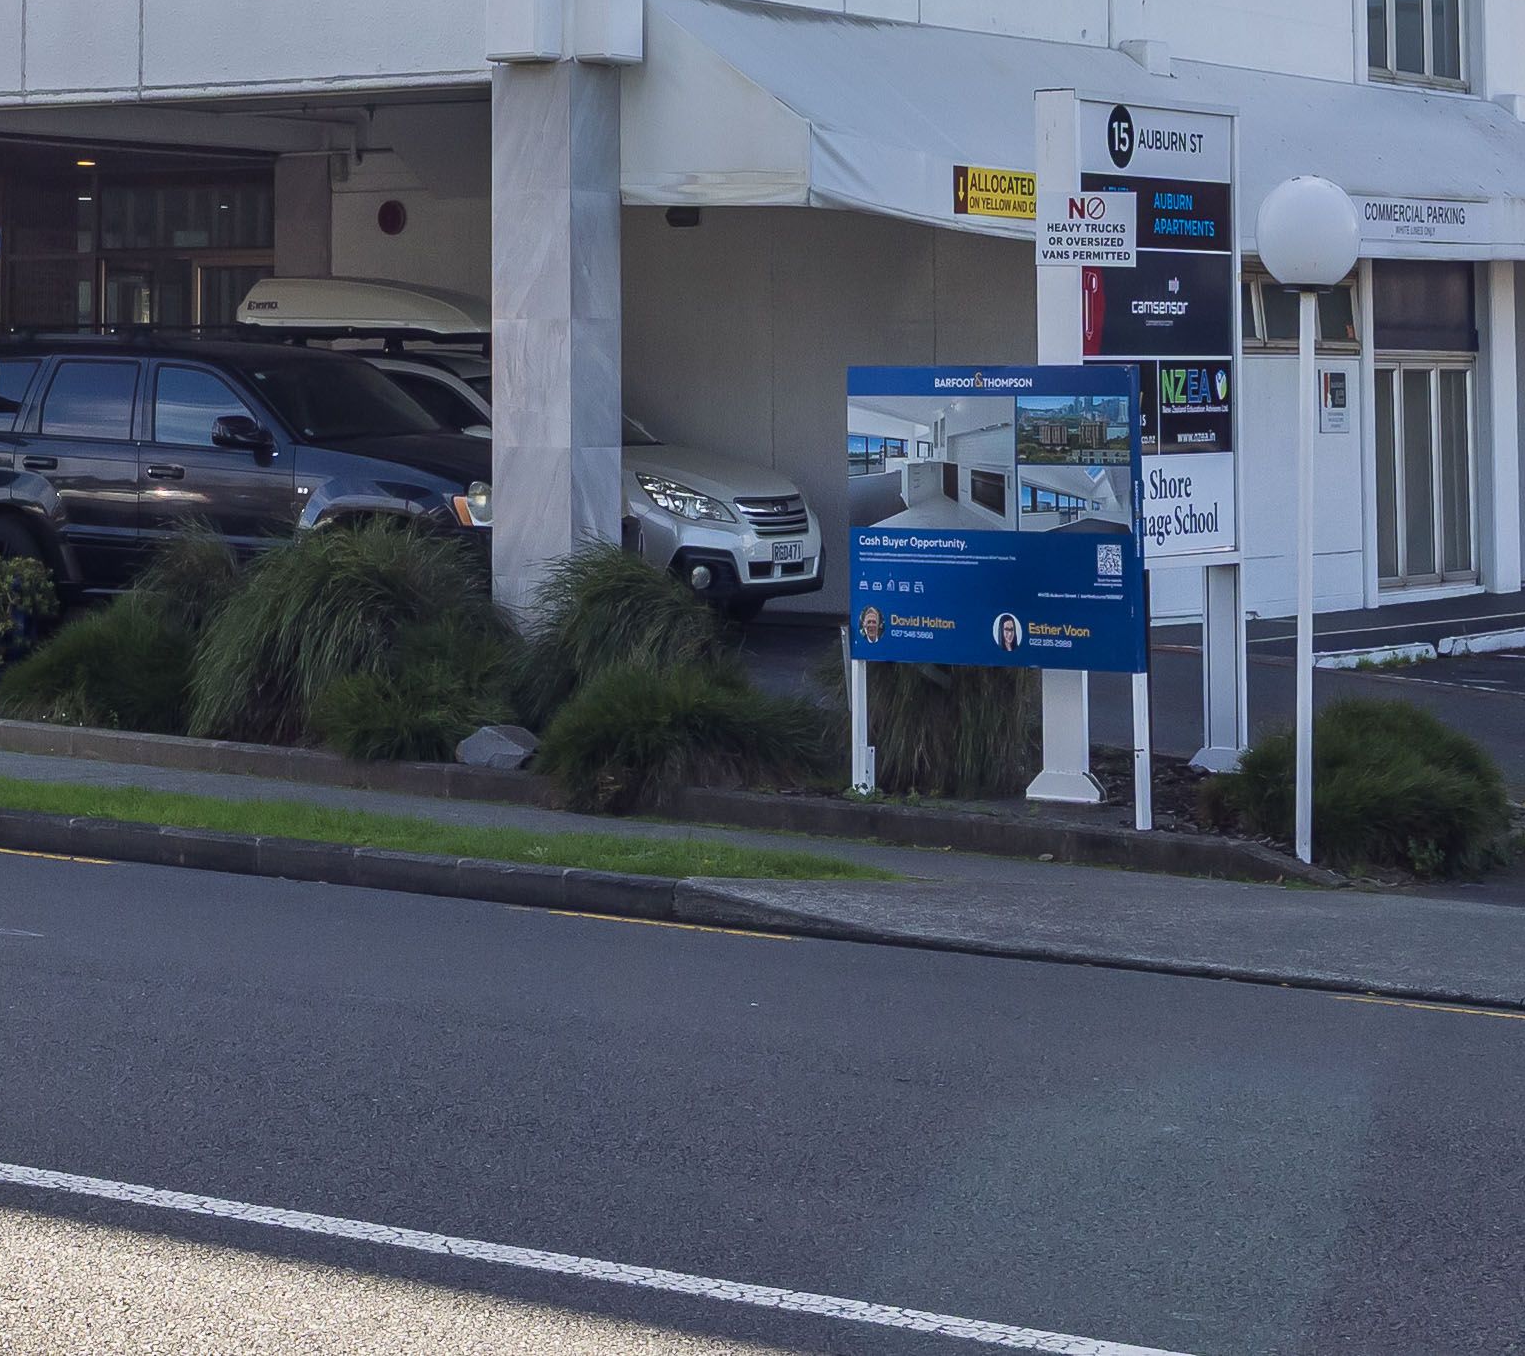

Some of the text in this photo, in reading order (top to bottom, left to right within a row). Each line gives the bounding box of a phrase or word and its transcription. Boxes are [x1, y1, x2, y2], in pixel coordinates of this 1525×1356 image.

[1112, 120, 1203, 154] 15 AUBURN ST
[970, 173, 1035, 195] ALLOCATED
[969, 198, 980, 210] ON
[981, 198, 1012, 212] YELLOW
[1013, 200, 1028, 214] AND
[1153, 192, 1192, 210] AUBURN
[1364, 202, 1465, 225] COMMERCIAL PARKING
[1047, 223, 1126, 234] HEAVY TRUCKS
[1153, 217, 1215, 237] APARTMENTS
[1048, 236, 1124, 247] OR OVERSIZED
[1042, 250, 1131, 261] VANS PERMITTED
[1131, 300, 1189, 316] camsensor
[1162, 369, 1211, 403] NZEA
[1150, 468, 1192, 500] Shore
[1175, 502, 1219, 536] School
[859, 535, 968, 551] Cash Buyer Opportunity.
[890, 614, 920, 627] David
[1028, 622, 1090, 637] Esther Voon
